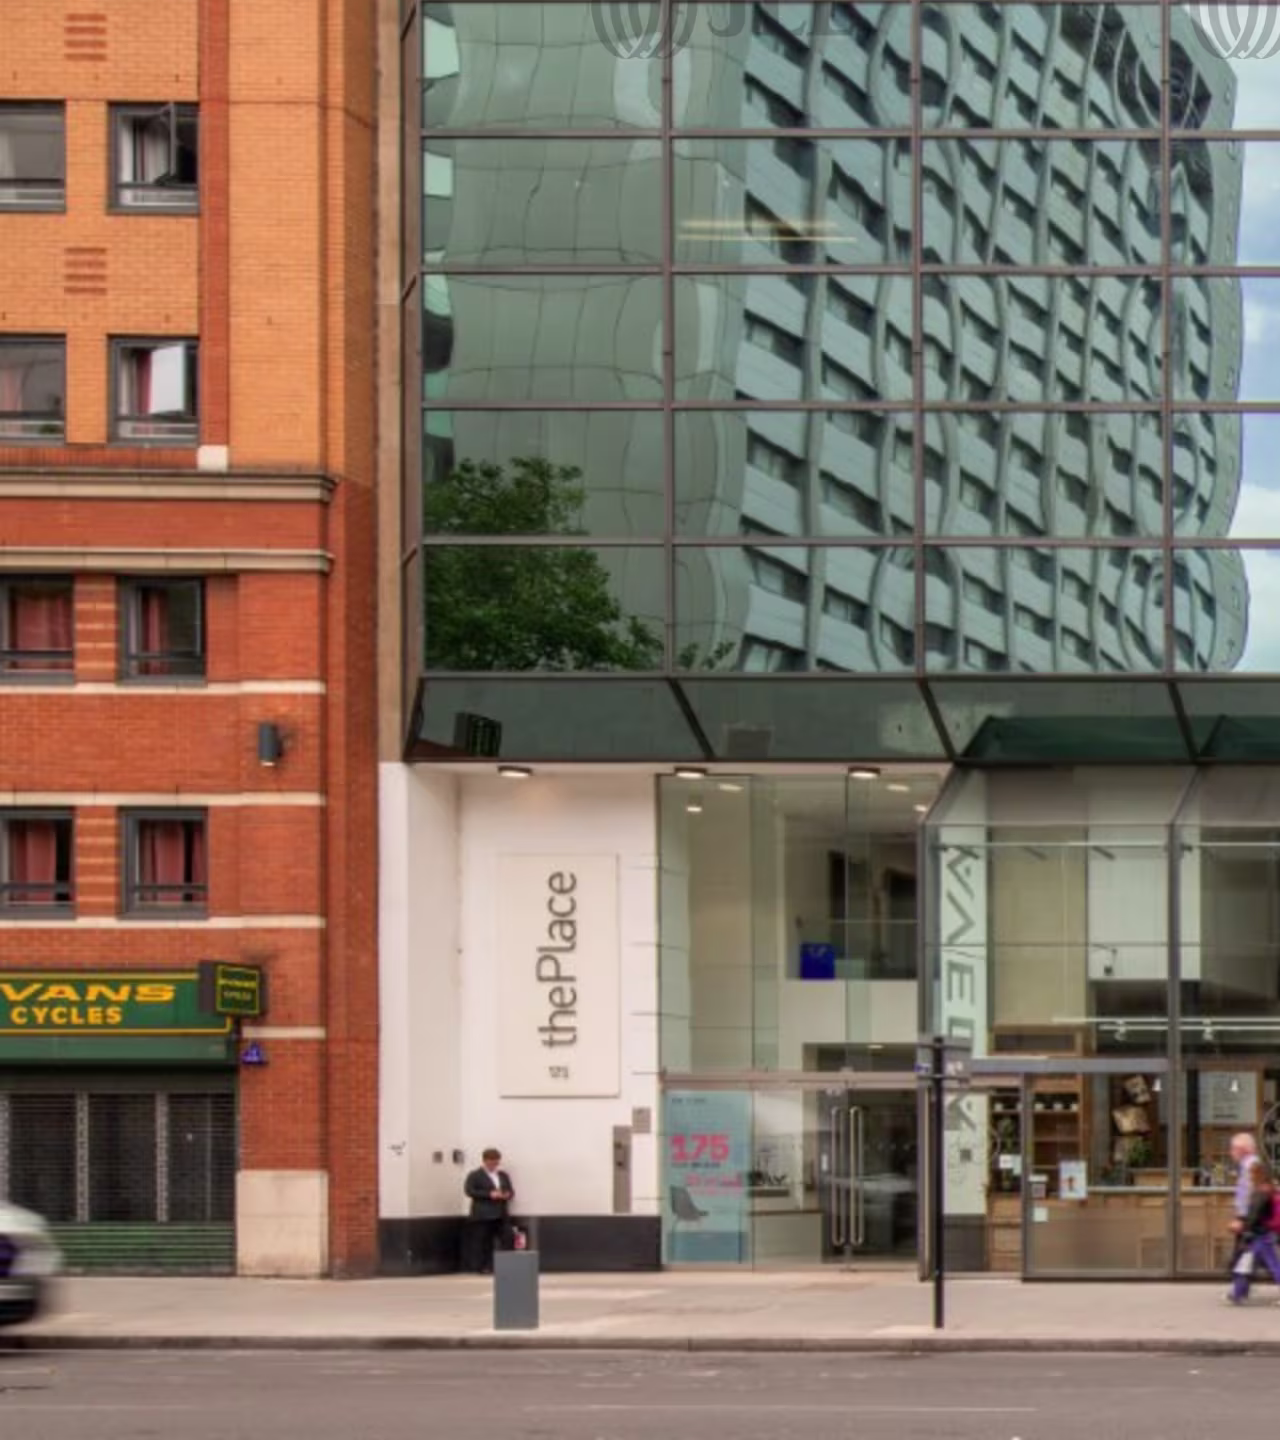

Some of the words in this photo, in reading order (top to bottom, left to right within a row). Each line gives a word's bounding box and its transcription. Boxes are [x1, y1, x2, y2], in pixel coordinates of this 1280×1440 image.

[535, 871, 577, 1049] thePlace
[10, 1006, 122, 1025] CYCLES
[671, 1133, 730, 1162] 175
